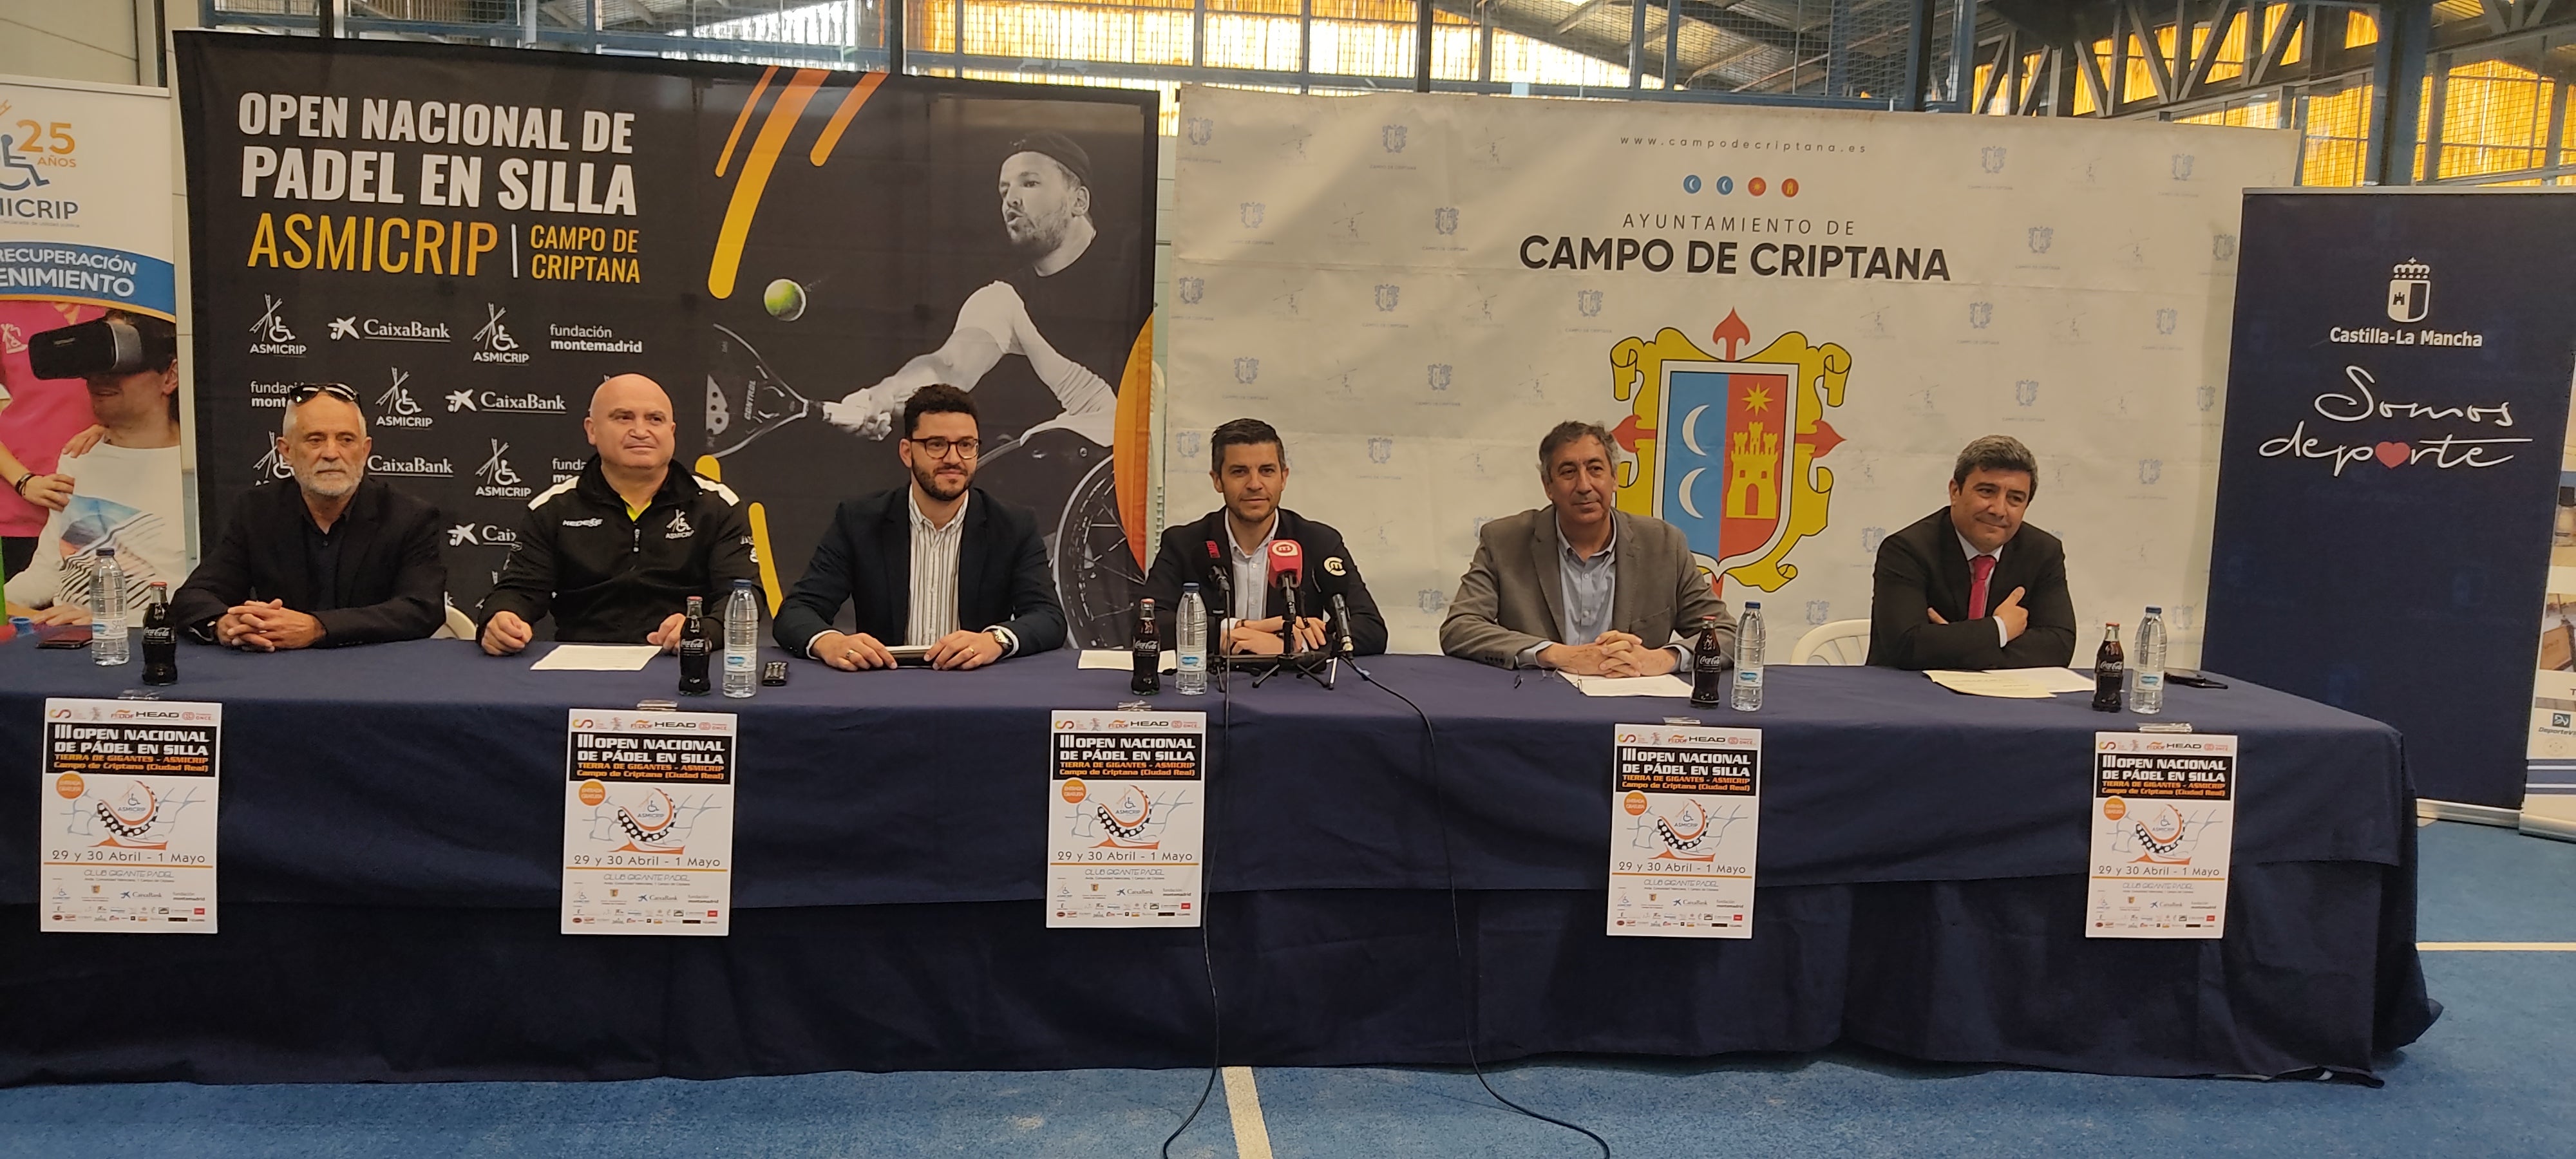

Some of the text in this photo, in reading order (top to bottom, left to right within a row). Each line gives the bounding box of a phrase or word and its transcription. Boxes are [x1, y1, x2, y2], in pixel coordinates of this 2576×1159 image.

[239, 92, 635, 153] OPEN NACIONAL DE
[16, 120, 75, 155] 25
[1620, 136, 1866, 153] www.campodecriptana.es
[37, 155, 77, 167] AÑOS
[241, 146, 637, 216] PADEL EN SILLA
[1623, 214, 1855, 236] AYUNTAMIENTO DE
[247, 212, 498, 276] ASMICRIP
[530, 225, 639, 253] CAMPO DE
[1520, 235, 1951, 281] CAMPO DE CRIPTANA
[531, 254, 640, 283] CRIPTANA
[364, 319, 450, 338] CaixaBank
[550, 324, 612, 337] fundación
[2330, 327, 2483, 347] Castilla-La Mancha
[250, 344, 307, 354] ASMICRIP
[551, 340, 642, 353] montemadrid
[473, 352, 529, 363] ASMICRIP
[481, 391, 566, 410] CaixaBank
[2314, 365, 2513, 427] Somos
[376, 416, 433, 427] ASMICRIP
[368, 455, 453, 473] CaixaBank
[475, 486, 531, 497] ASMICRIP
[54, 724, 209, 742] III OPEN NACIONAL
[55, 740, 209, 755] DE PÁDEL EN SILLA
[577, 734, 725, 751] III OPEN NACIONAL
[1059, 735, 1196, 749] III OPEN NACIONAL
[577, 749, 724, 764] DE PÁDEL EN SILLA
[1060, 749, 1195, 760] DE PÁDEL EN SILLA
[1622, 748, 1751, 765] III OPEN NACIONAL
[1622, 762, 1750, 777] DE PÁDEL EN SILLA
[2116, 758, 2153, 768] OPEN
[2157, 759, 2226, 770] NACIONAL
[2102, 769, 2225, 782] DE PÁDEL EN SILLA
[52, 850, 68, 860] 29
[74, 852, 81, 862] y
[87, 851, 102, 860] 30
[108, 851, 140, 861] Abril
[158, 853, 162, 861] 1
[171, 853, 205, 864] Mayo
[574, 855, 589, 864] 29
[595, 857, 601, 866] y
[607, 856, 622, 865] 30
[628, 856, 658, 865] Abril
[676, 857, 679, 865] 1
[687, 858, 720, 869] Mayo
[1057, 851, 1072, 860] 29
[1077, 853, 1083, 862] y
[1088, 851, 1102, 860] 30
[1107, 851, 1135, 860] Abril
[1162, 852, 1192, 862] Mayo
[1618, 862, 1632, 870] 29
[1637, 863, 1643, 872] y
[1647, 862, 1660, 871] 30
[1665, 862, 1692, 872] Abril
[1717, 865, 1746, 875] Mayo
[2098, 865, 2111, 874] 29
[2116, 867, 2121, 876] y
[2126, 865, 2139, 874] 30
[2143, 866, 2168, 874] Abril
[2193, 868, 2221, 878] Mayo
